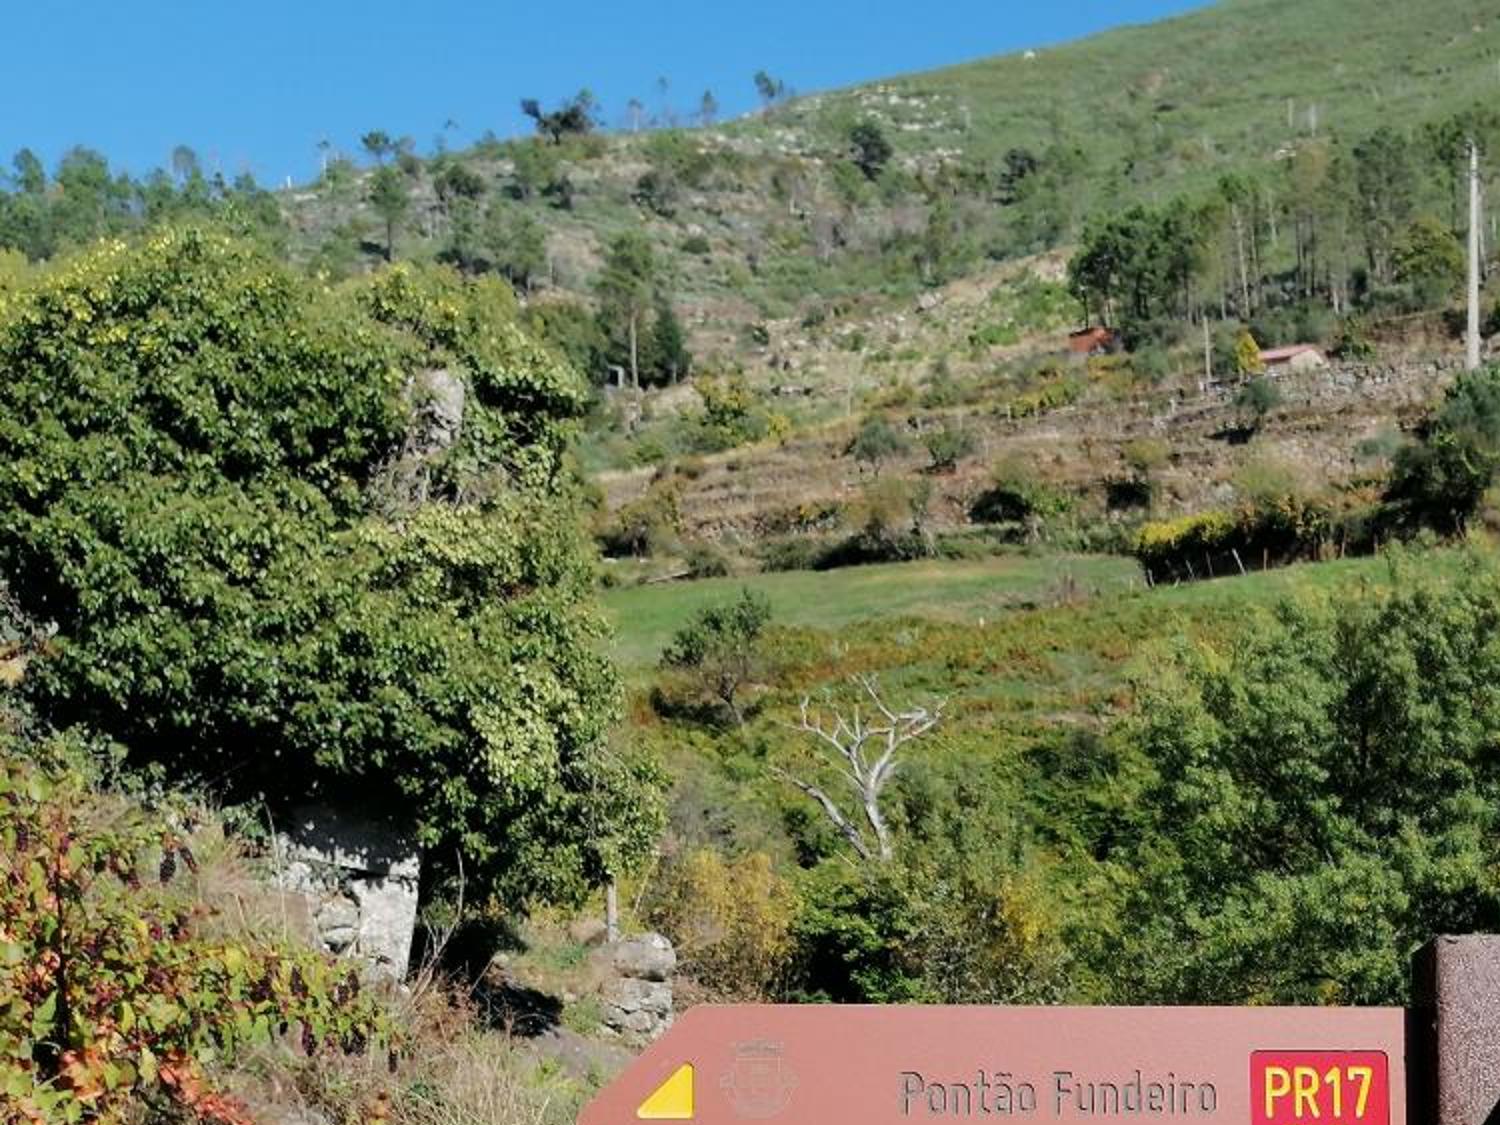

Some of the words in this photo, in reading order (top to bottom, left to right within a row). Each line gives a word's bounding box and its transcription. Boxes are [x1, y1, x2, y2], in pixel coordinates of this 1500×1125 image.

[900, 1069, 1037, 1115] Pontão
[1052, 1069, 1217, 1115] Fundeiro
[1265, 1066, 1373, 1119] PR17
